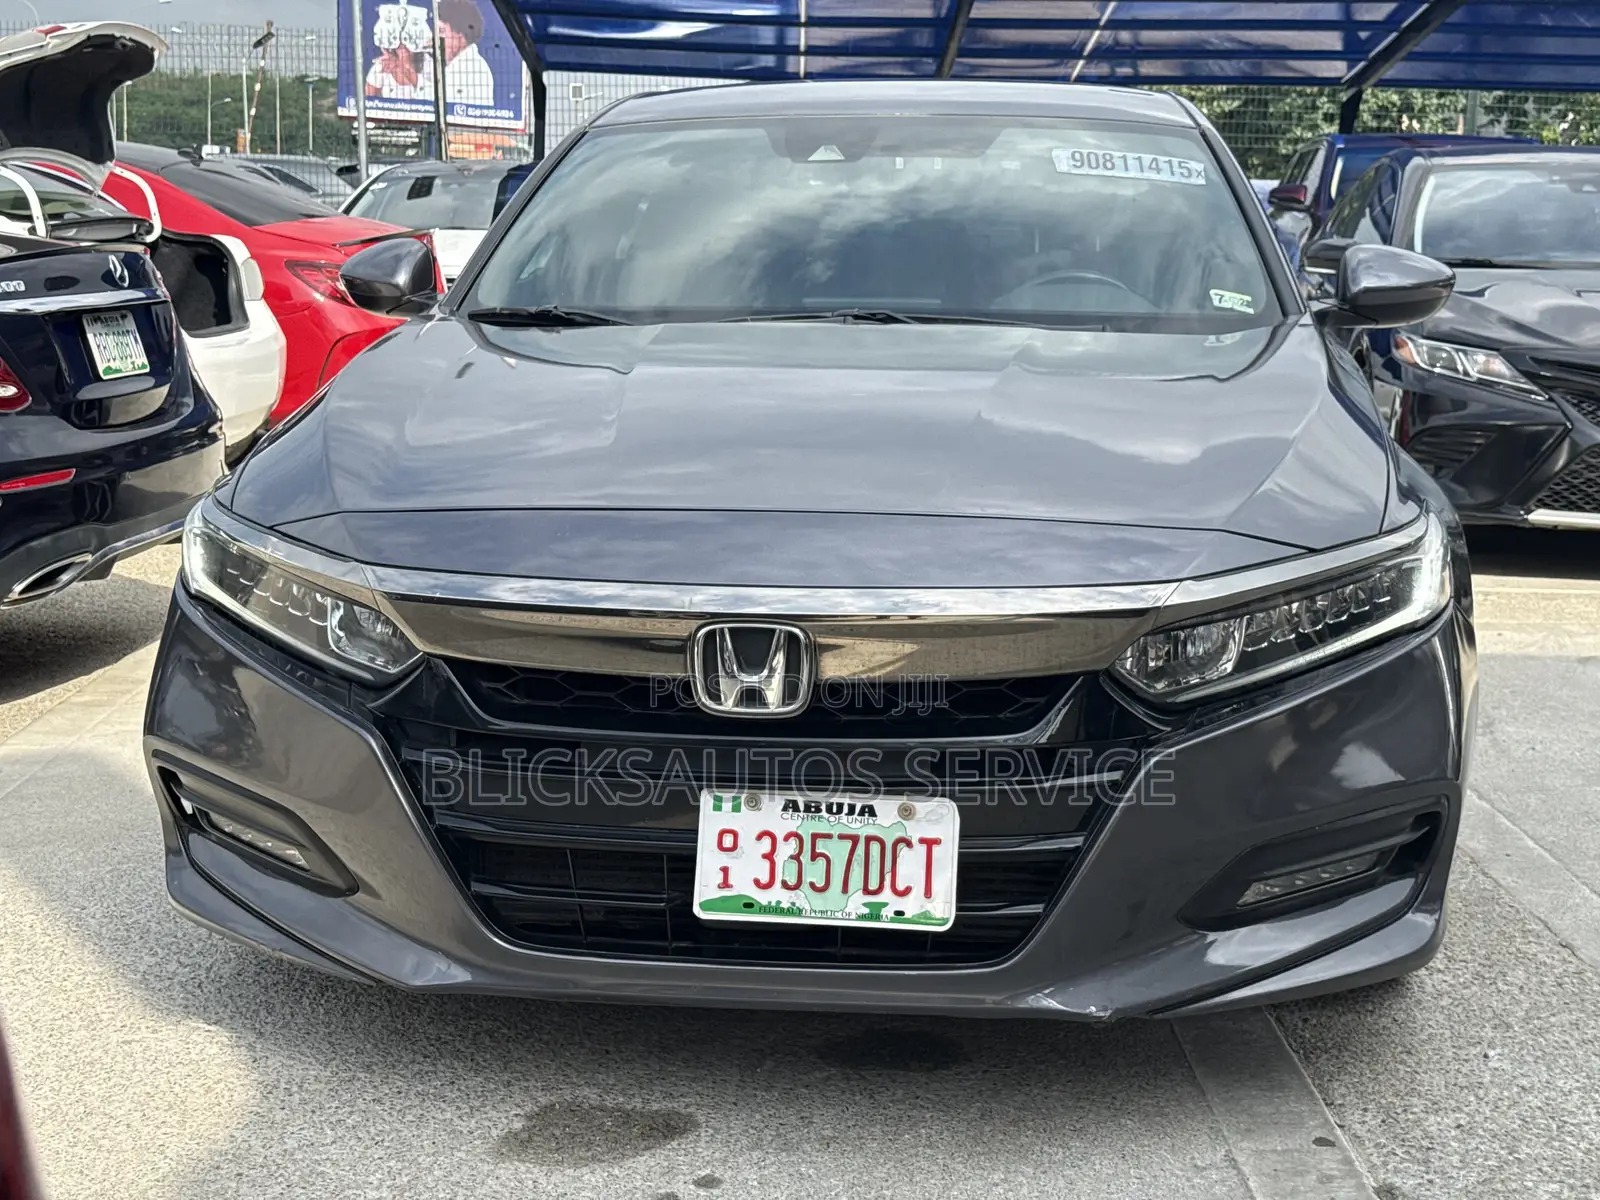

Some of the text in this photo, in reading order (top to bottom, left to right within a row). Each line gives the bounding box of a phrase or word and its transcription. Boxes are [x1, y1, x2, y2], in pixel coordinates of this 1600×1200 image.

[781, 799, 878, 818] ABUJA
[780, 813, 878, 825] CENTRE OF UNITY
[758, 905, 890, 921] FEDERAL REPUBLIC OF NIGERIA
